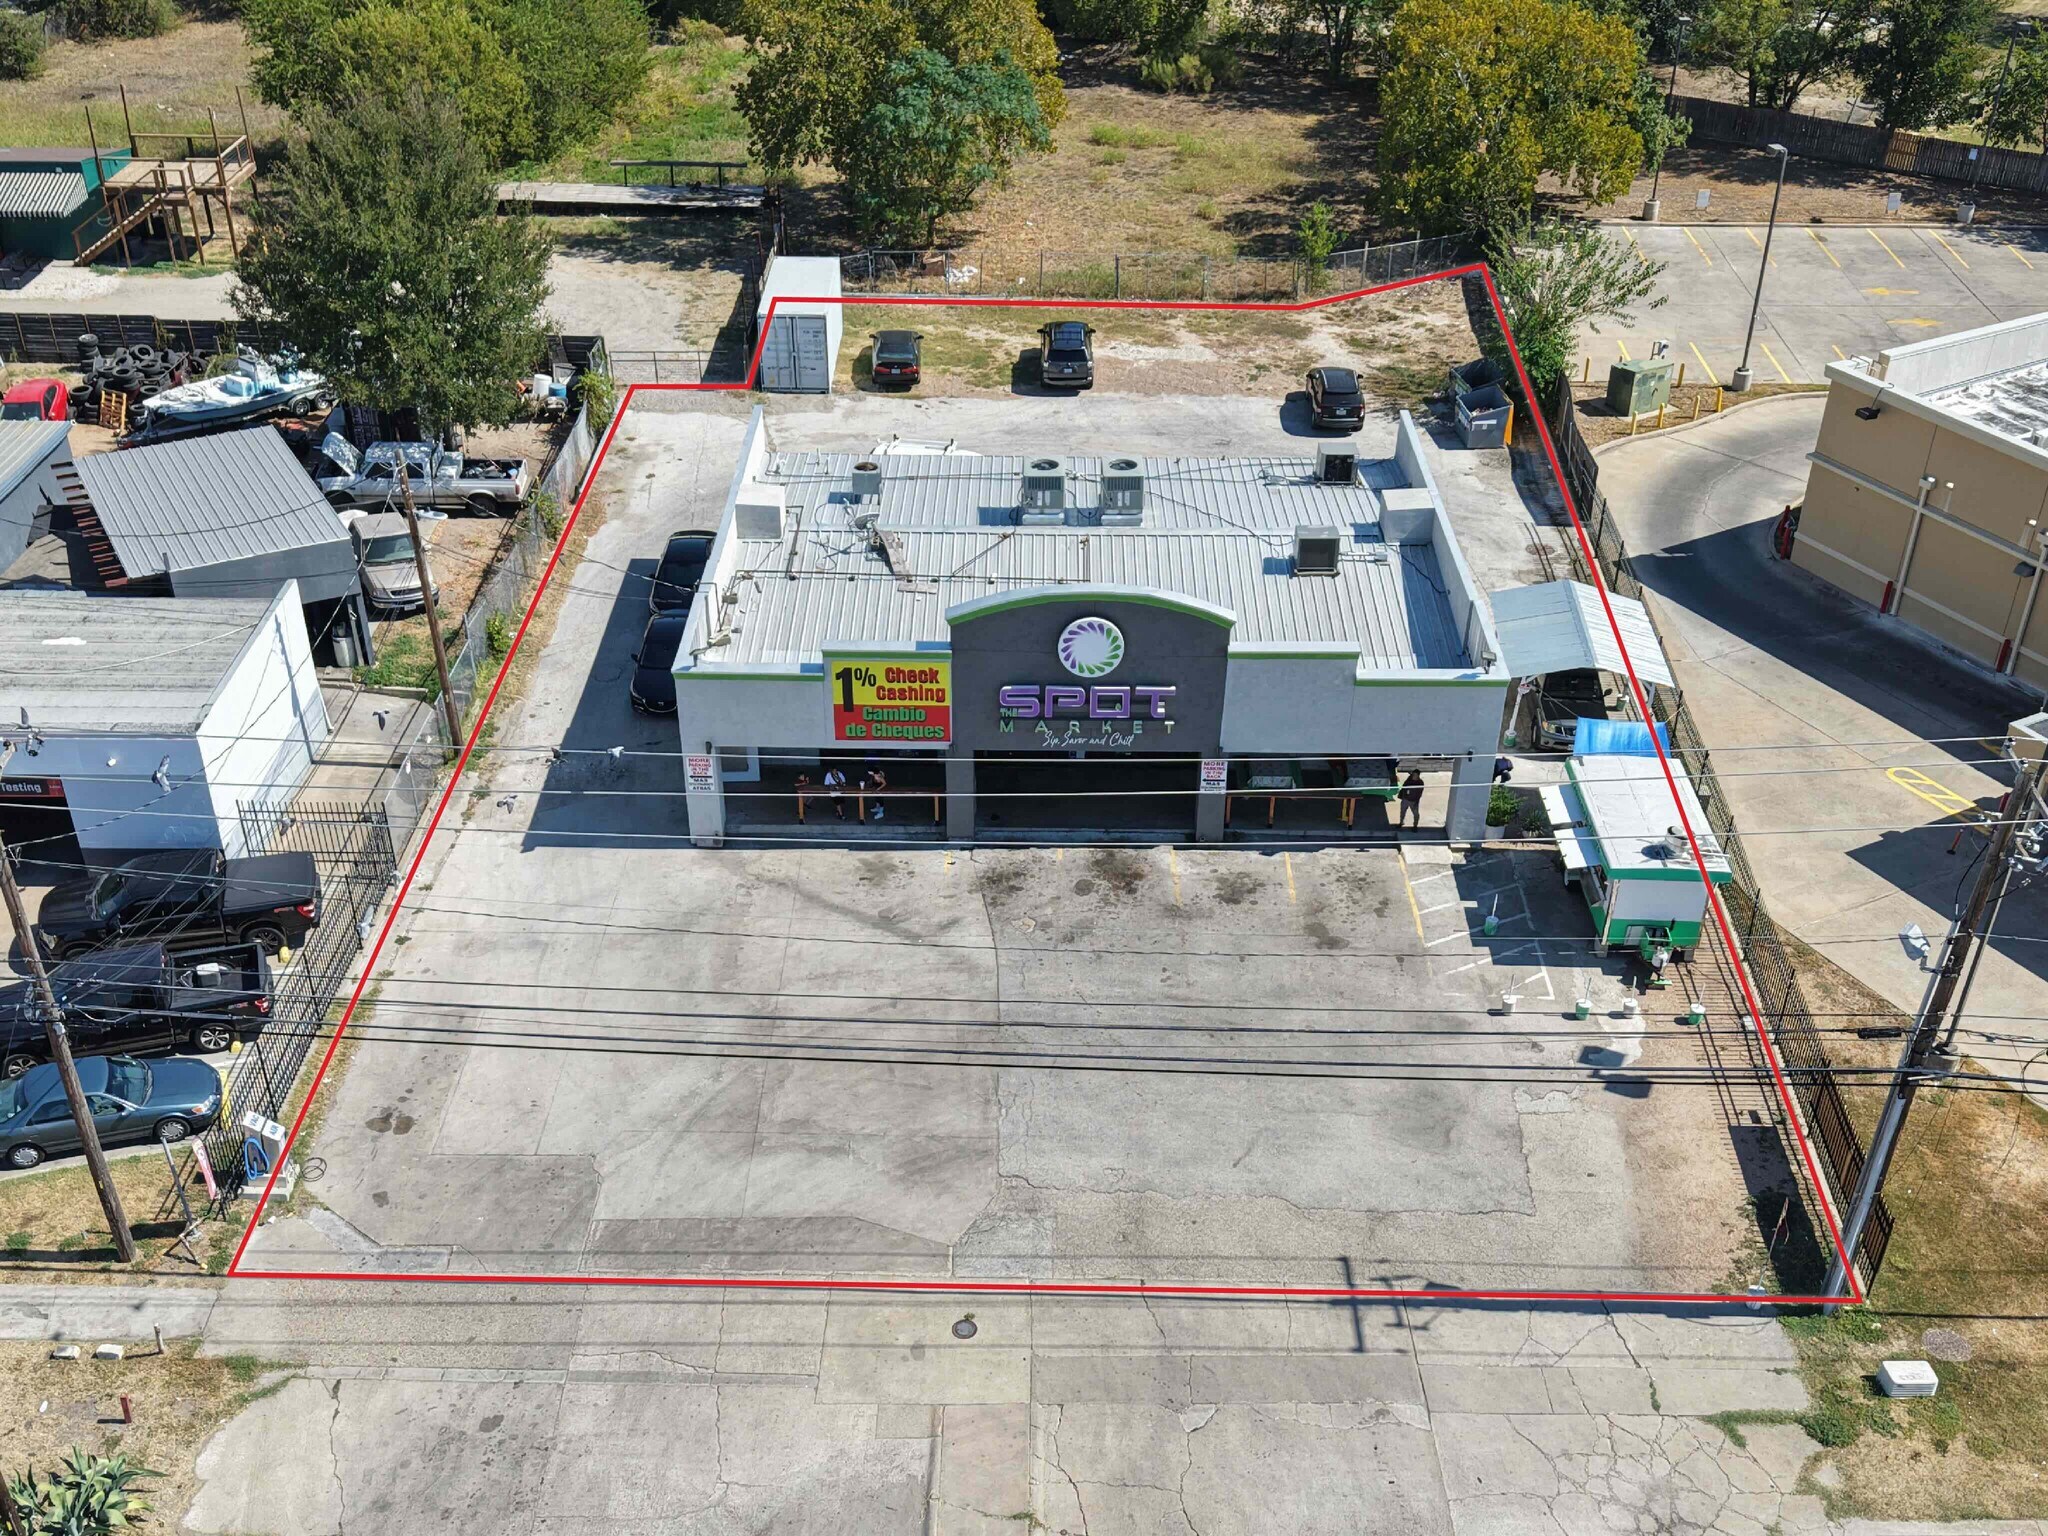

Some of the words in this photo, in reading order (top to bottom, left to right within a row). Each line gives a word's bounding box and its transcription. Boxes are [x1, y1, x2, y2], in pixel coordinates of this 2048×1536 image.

[885, 667, 940, 684] Check
[836, 667, 876, 712] 1%
[876, 684, 946, 703] Cashing
[1000, 685, 1176, 718] SPOT
[862, 706, 927, 722] Cambio
[1000, 708, 1018, 717] THE
[845, 723, 868, 738] de
[871, 723, 945, 740] Cheques
[1000, 720, 1175, 734] MARKET
[1088, 735, 1108, 746] and
[0, 782, 41, 793] Testing
